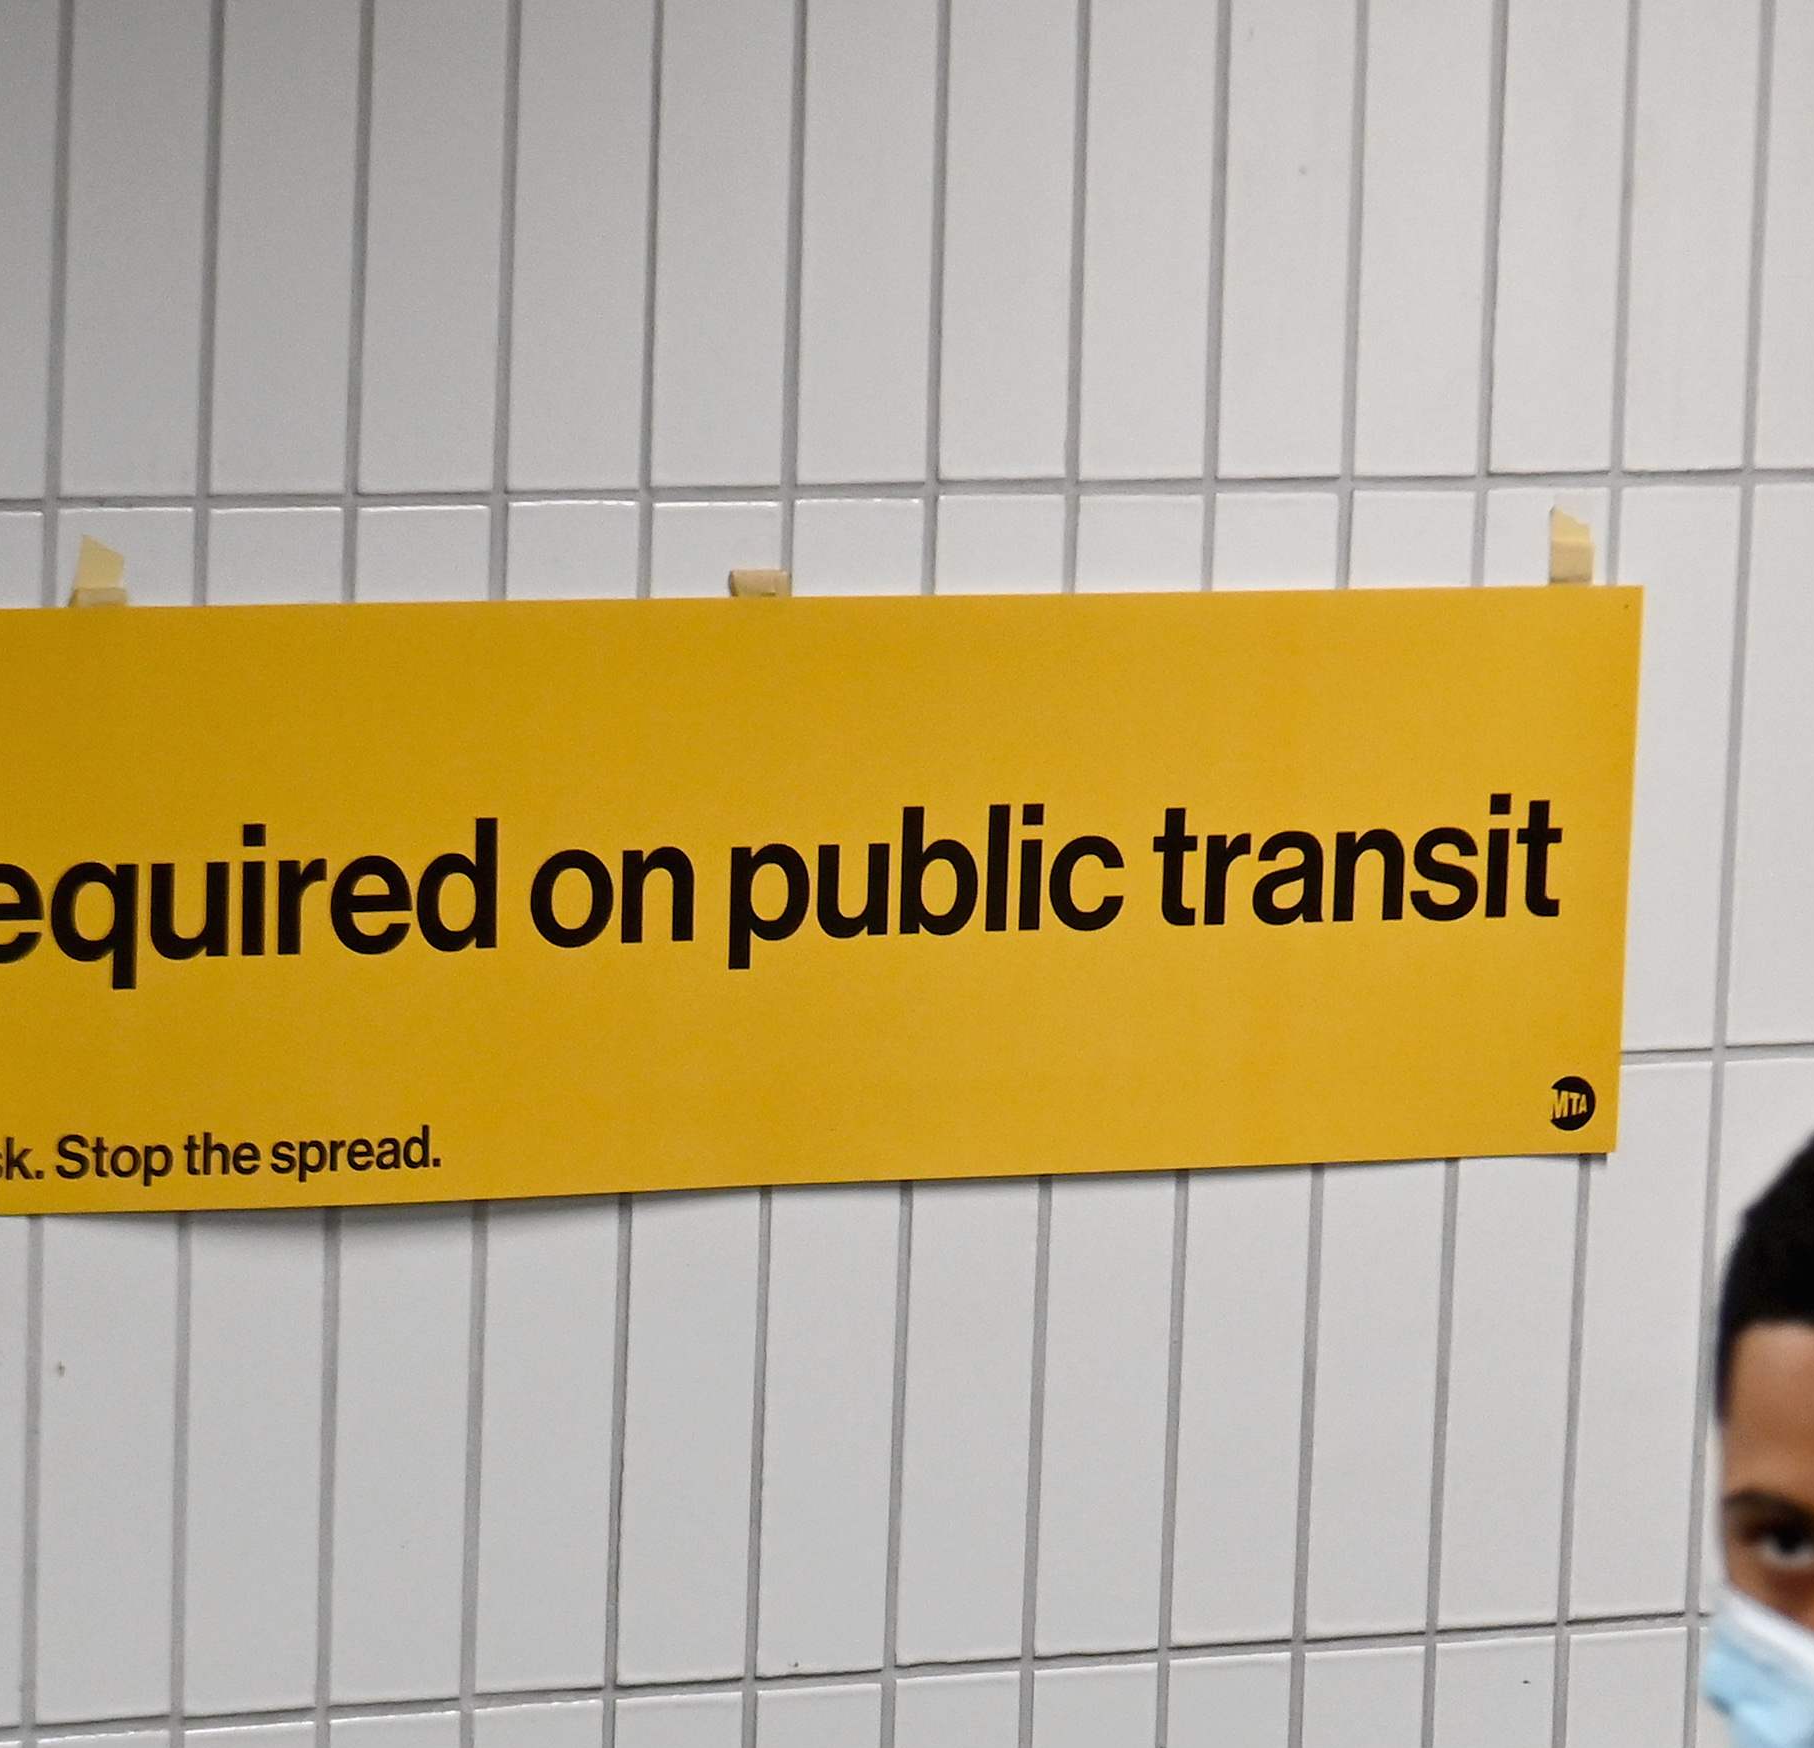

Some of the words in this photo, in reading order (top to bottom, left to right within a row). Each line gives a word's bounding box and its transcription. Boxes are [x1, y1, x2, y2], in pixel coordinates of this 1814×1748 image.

[528, 845, 696, 950] on
[727, 803, 1126, 971] public
[1151, 792, 1564, 928] transit
[1549, 1086, 1590, 1122] MTA
[54, 1134, 175, 1188] Stop
[183, 1131, 262, 1177] the
[270, 1124, 442, 1184] spread.
